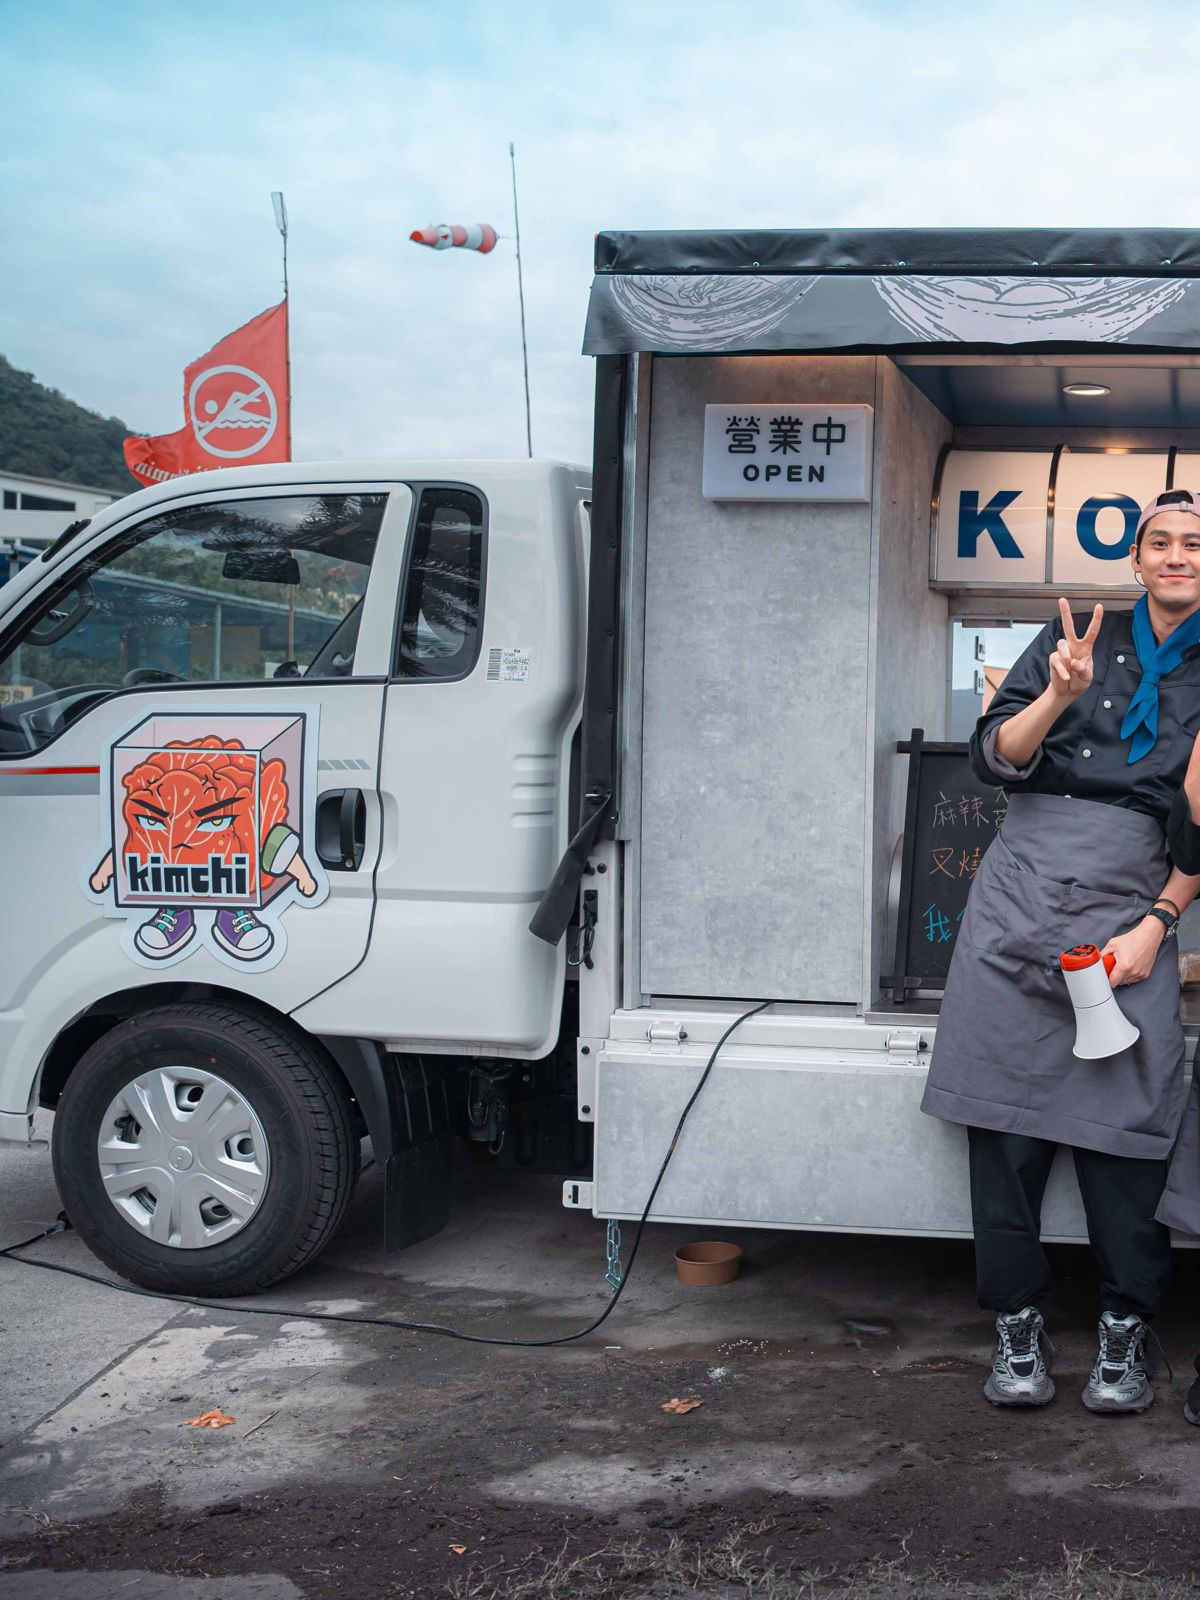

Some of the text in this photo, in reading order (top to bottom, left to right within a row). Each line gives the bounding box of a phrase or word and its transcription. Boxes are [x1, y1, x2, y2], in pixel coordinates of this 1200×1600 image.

[726, 415, 846, 455] 營業中
[743, 464, 825, 483] OPEN
[128, 856, 247, 894] kimchi
[922, 903, 966, 943] 我
